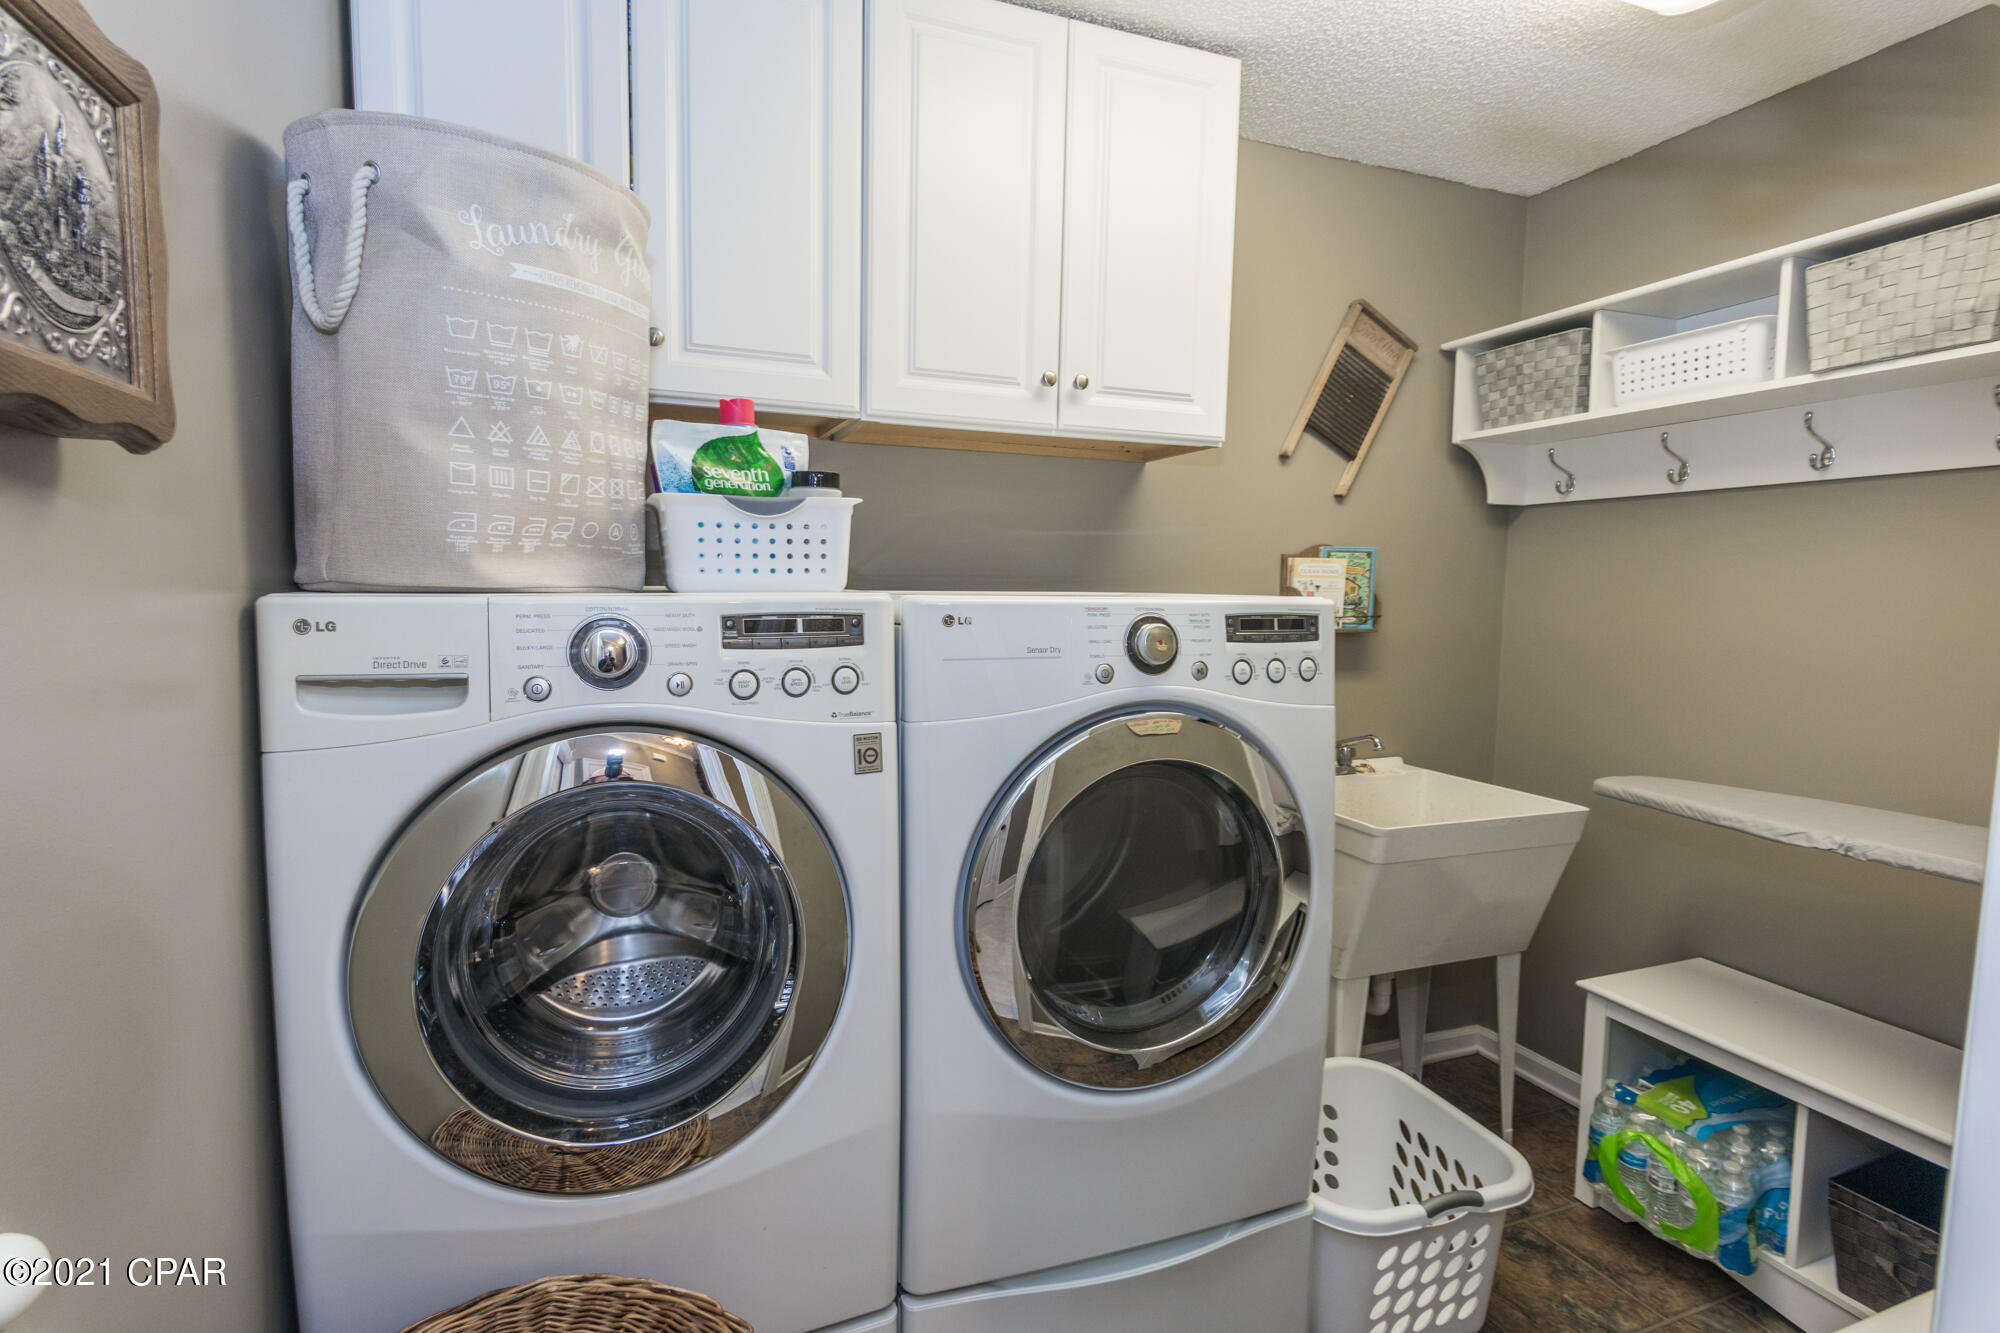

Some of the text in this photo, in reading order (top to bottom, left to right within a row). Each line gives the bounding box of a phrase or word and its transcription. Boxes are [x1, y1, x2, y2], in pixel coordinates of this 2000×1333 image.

[458, 203, 601, 273] Laundry
[702, 465, 770, 482] seventh
[315, 620, 337, 632] LG
[1050, 646, 1062, 655] Dry
[373, 660, 427, 669] Direct Drive
[857, 746, 879, 765] 10
[1763, 1207, 1786, 1221] Pu
